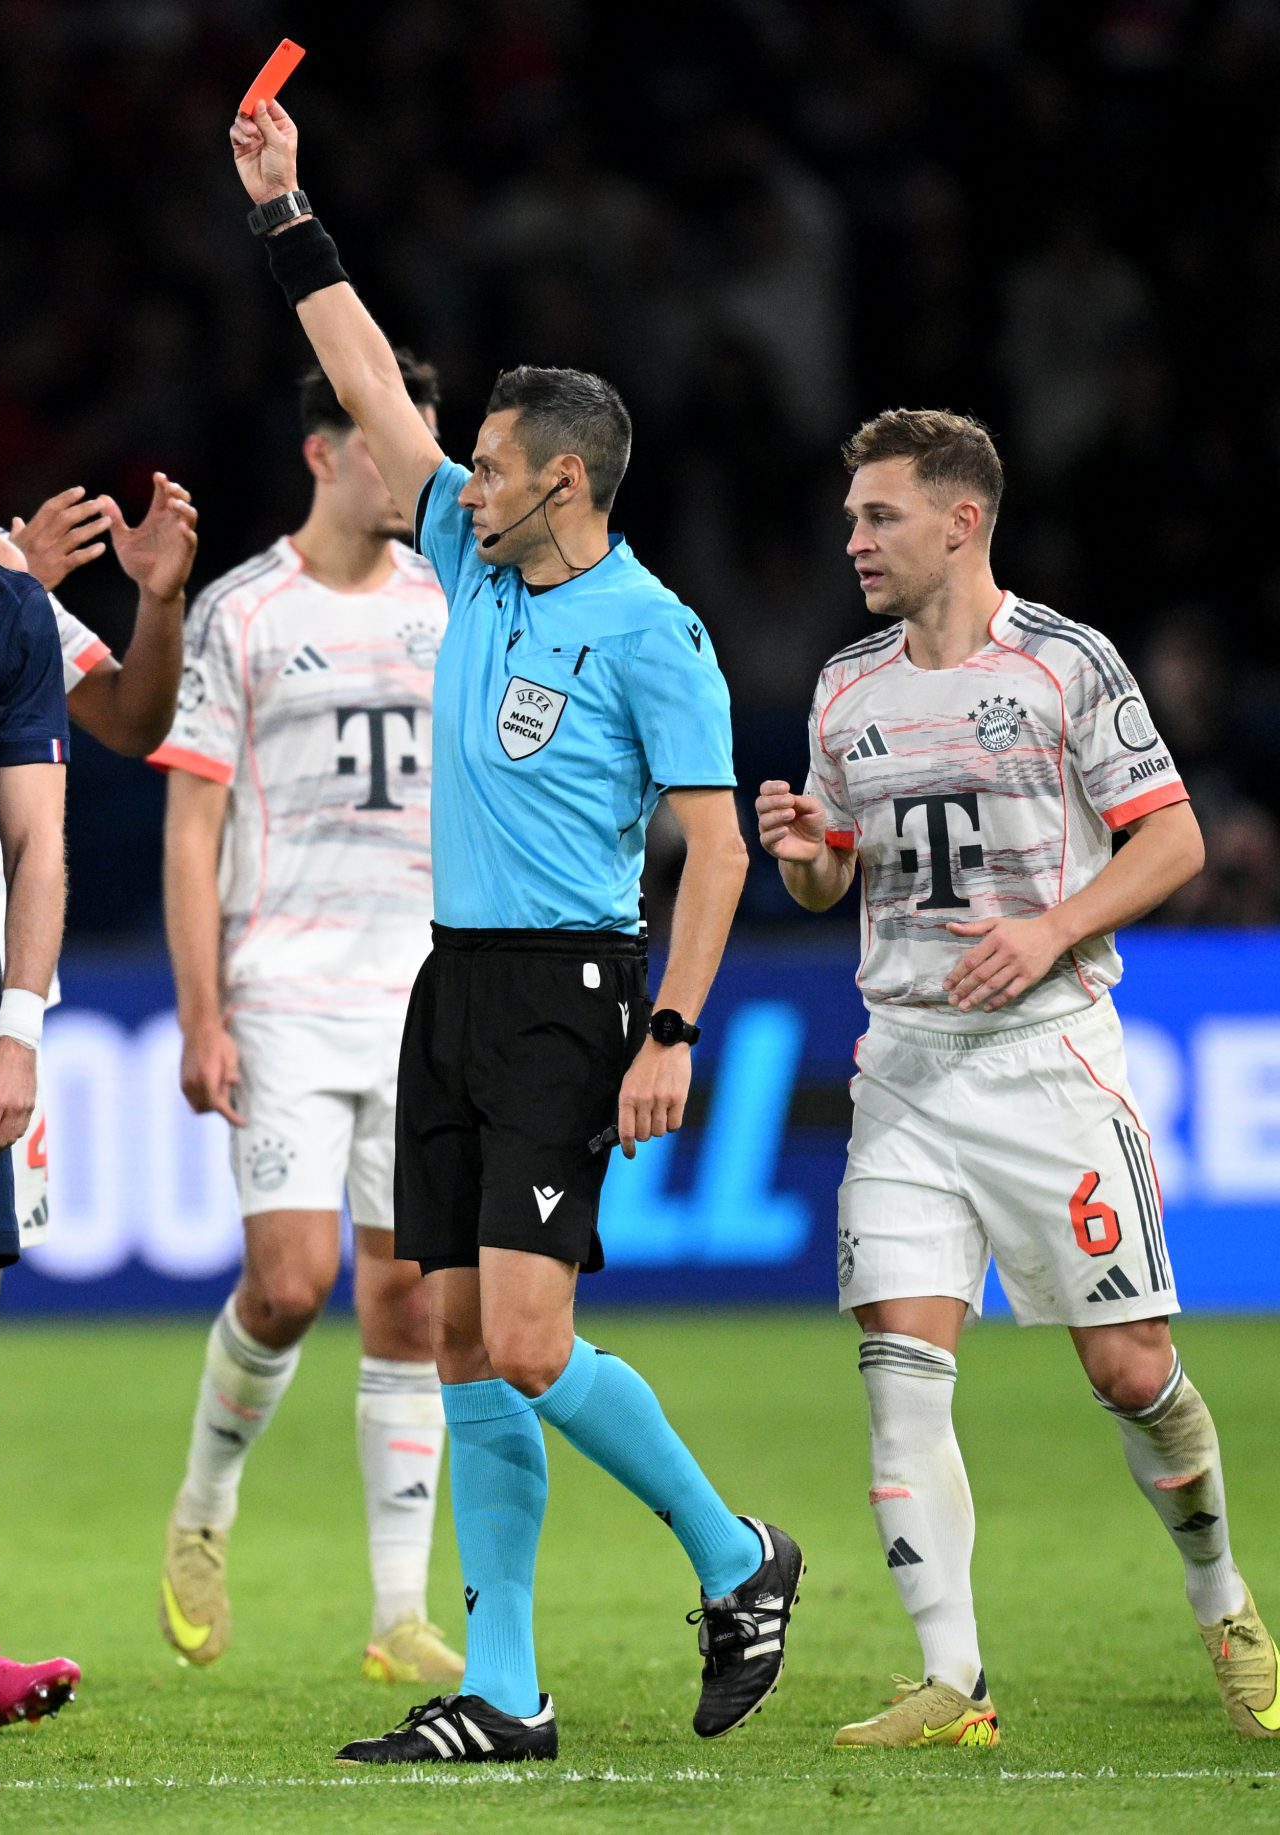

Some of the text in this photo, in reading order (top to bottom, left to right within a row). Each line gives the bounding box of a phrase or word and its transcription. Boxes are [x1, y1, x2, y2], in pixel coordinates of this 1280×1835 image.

[517, 692, 549, 712] UEFA
[510, 711, 543, 729] MATCH
[988, 710, 1017, 727] BAYERN
[503, 721, 541, 742] OFFICIAL
[893, 793, 984, 910] T
[1069, 1171, 1122, 1257] 6
